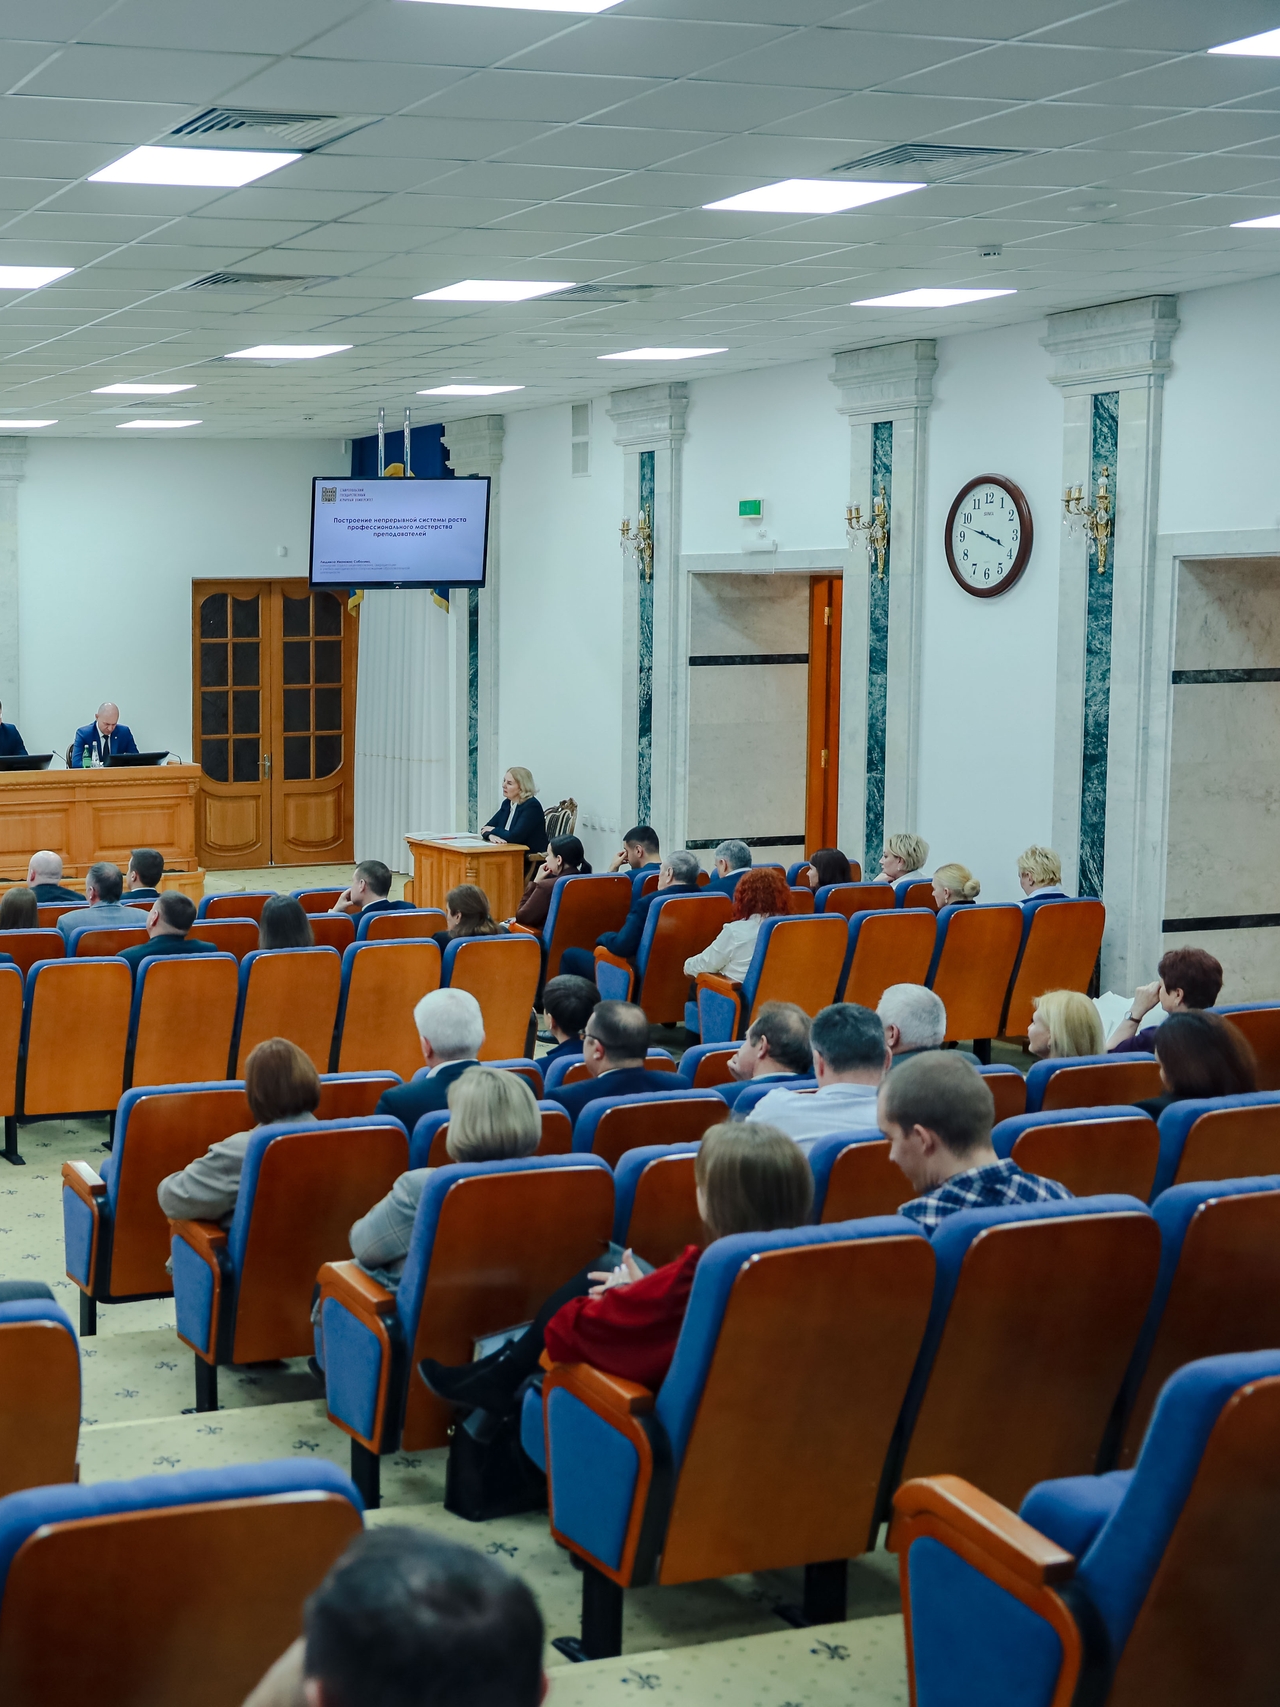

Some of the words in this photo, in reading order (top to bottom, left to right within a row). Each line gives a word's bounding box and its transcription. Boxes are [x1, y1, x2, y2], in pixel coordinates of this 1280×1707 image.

[973, 498, 981, 510] 11
[984, 492, 995, 504] 12
[1000, 497, 1005, 509] 1
[373, 516, 418, 524] непрерывной
[963, 512, 972, 525] 10
[1008, 509, 1015, 522] 2
[959, 530, 966, 543] 9
[1012, 528, 1019, 541] 3
[962, 549, 969, 561] 8
[1006, 547, 1013, 560] 4
[971, 563, 977, 575] 7
[983, 567, 990, 580] 6
[996, 562, 1003, 575] 5
